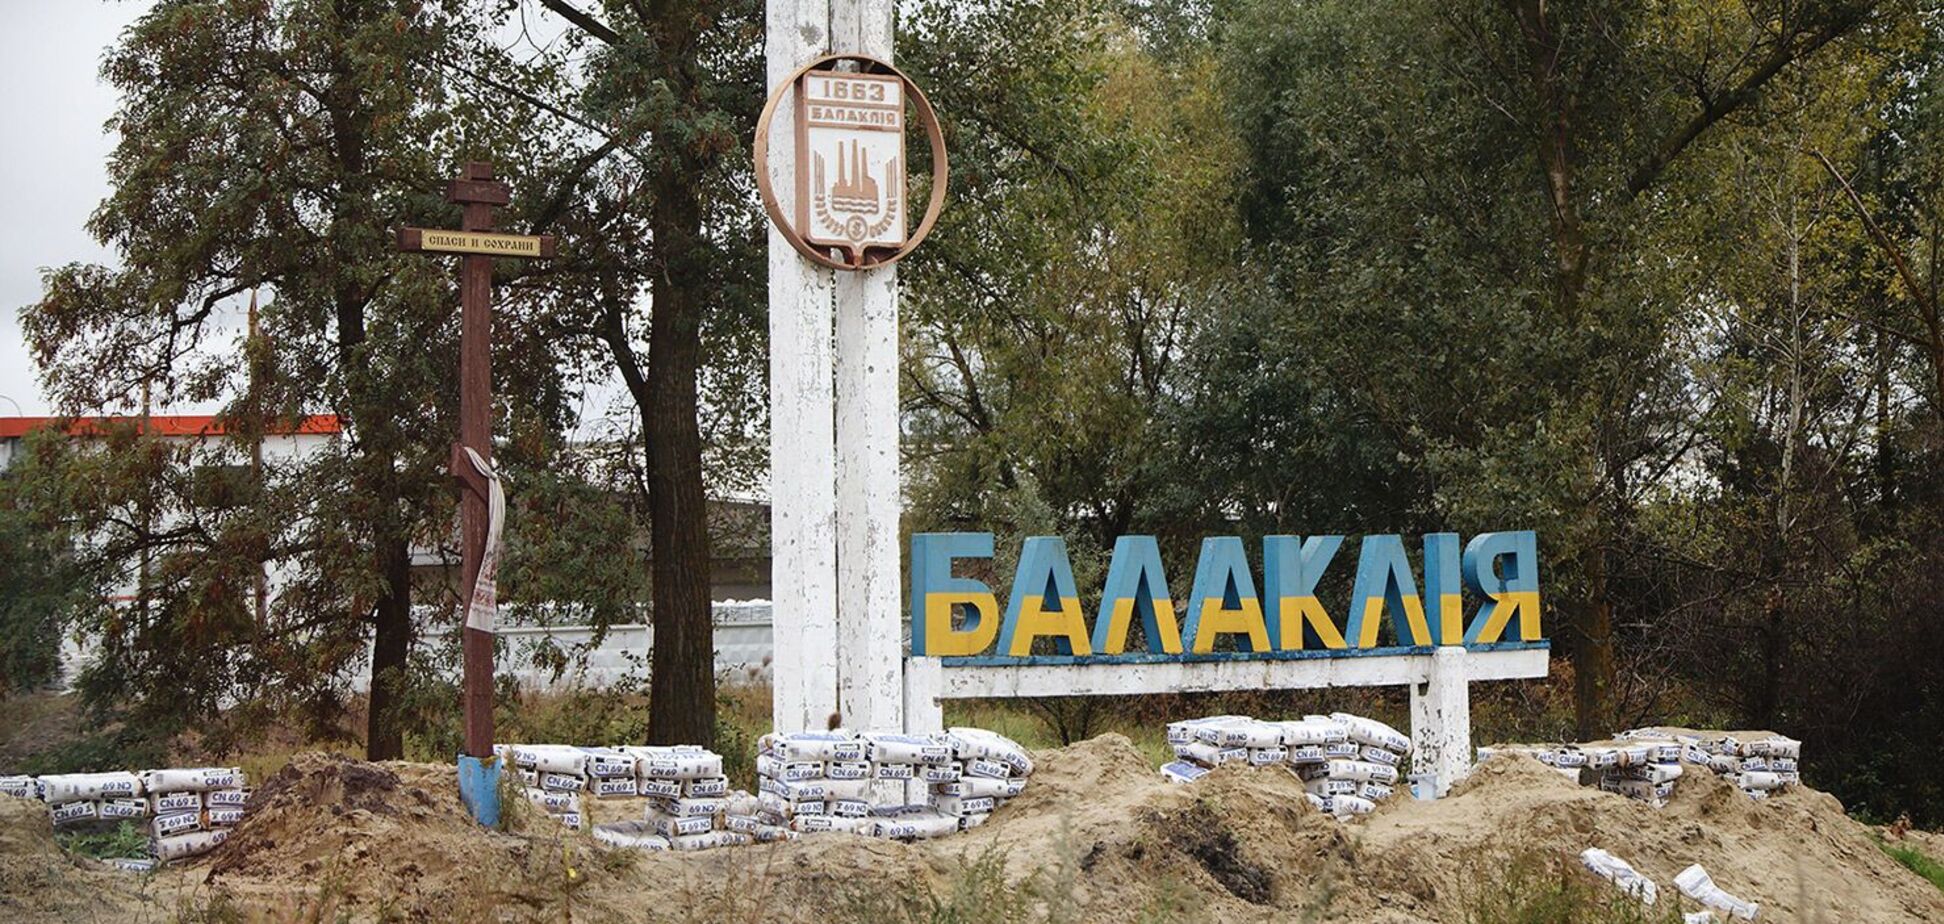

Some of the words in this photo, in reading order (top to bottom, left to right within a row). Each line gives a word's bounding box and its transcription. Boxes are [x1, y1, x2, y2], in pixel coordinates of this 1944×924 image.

[823, 80, 885, 102] 1663
[811, 107, 896, 126] БАЛАКЛІЯ
[429, 236, 466, 247] СПАСИ
[471, 239, 479, 247] И
[484, 239, 533, 251] СОХРАНИ
[911, 531, 1542, 657] БАЛАКЛІЯ
[835, 752, 848, 760] CN
[595, 764, 609, 772] CN
[611, 763, 622, 772] 69
[651, 768, 664, 776] CN
[665, 768, 677, 776] 69
[880, 768, 893, 777] CN
[895, 768, 905, 777] 69
[205, 778, 219, 786] CN
[221, 777, 233, 785] 69
[547, 776, 561, 785] CN
[562, 779, 574, 788] 69
[601, 783, 614, 791] CN
[616, 782, 628, 791] 69
[647, 783, 660, 791] CN
[661, 784, 673, 793] 69
[692, 785, 707, 793] CN
[708, 783, 719, 791] 69
[160, 799, 174, 808] CN
[176, 797, 188, 806] 69
[212, 793, 226, 801] CN
[228, 793, 240, 802] 69
[54, 810, 68, 819] CN
[71, 807, 83, 818] 69
[105, 805, 118, 815] CN
[120, 806, 133, 816] 69
[168, 818, 180, 827] 69
[183, 815, 197, 824] CN
